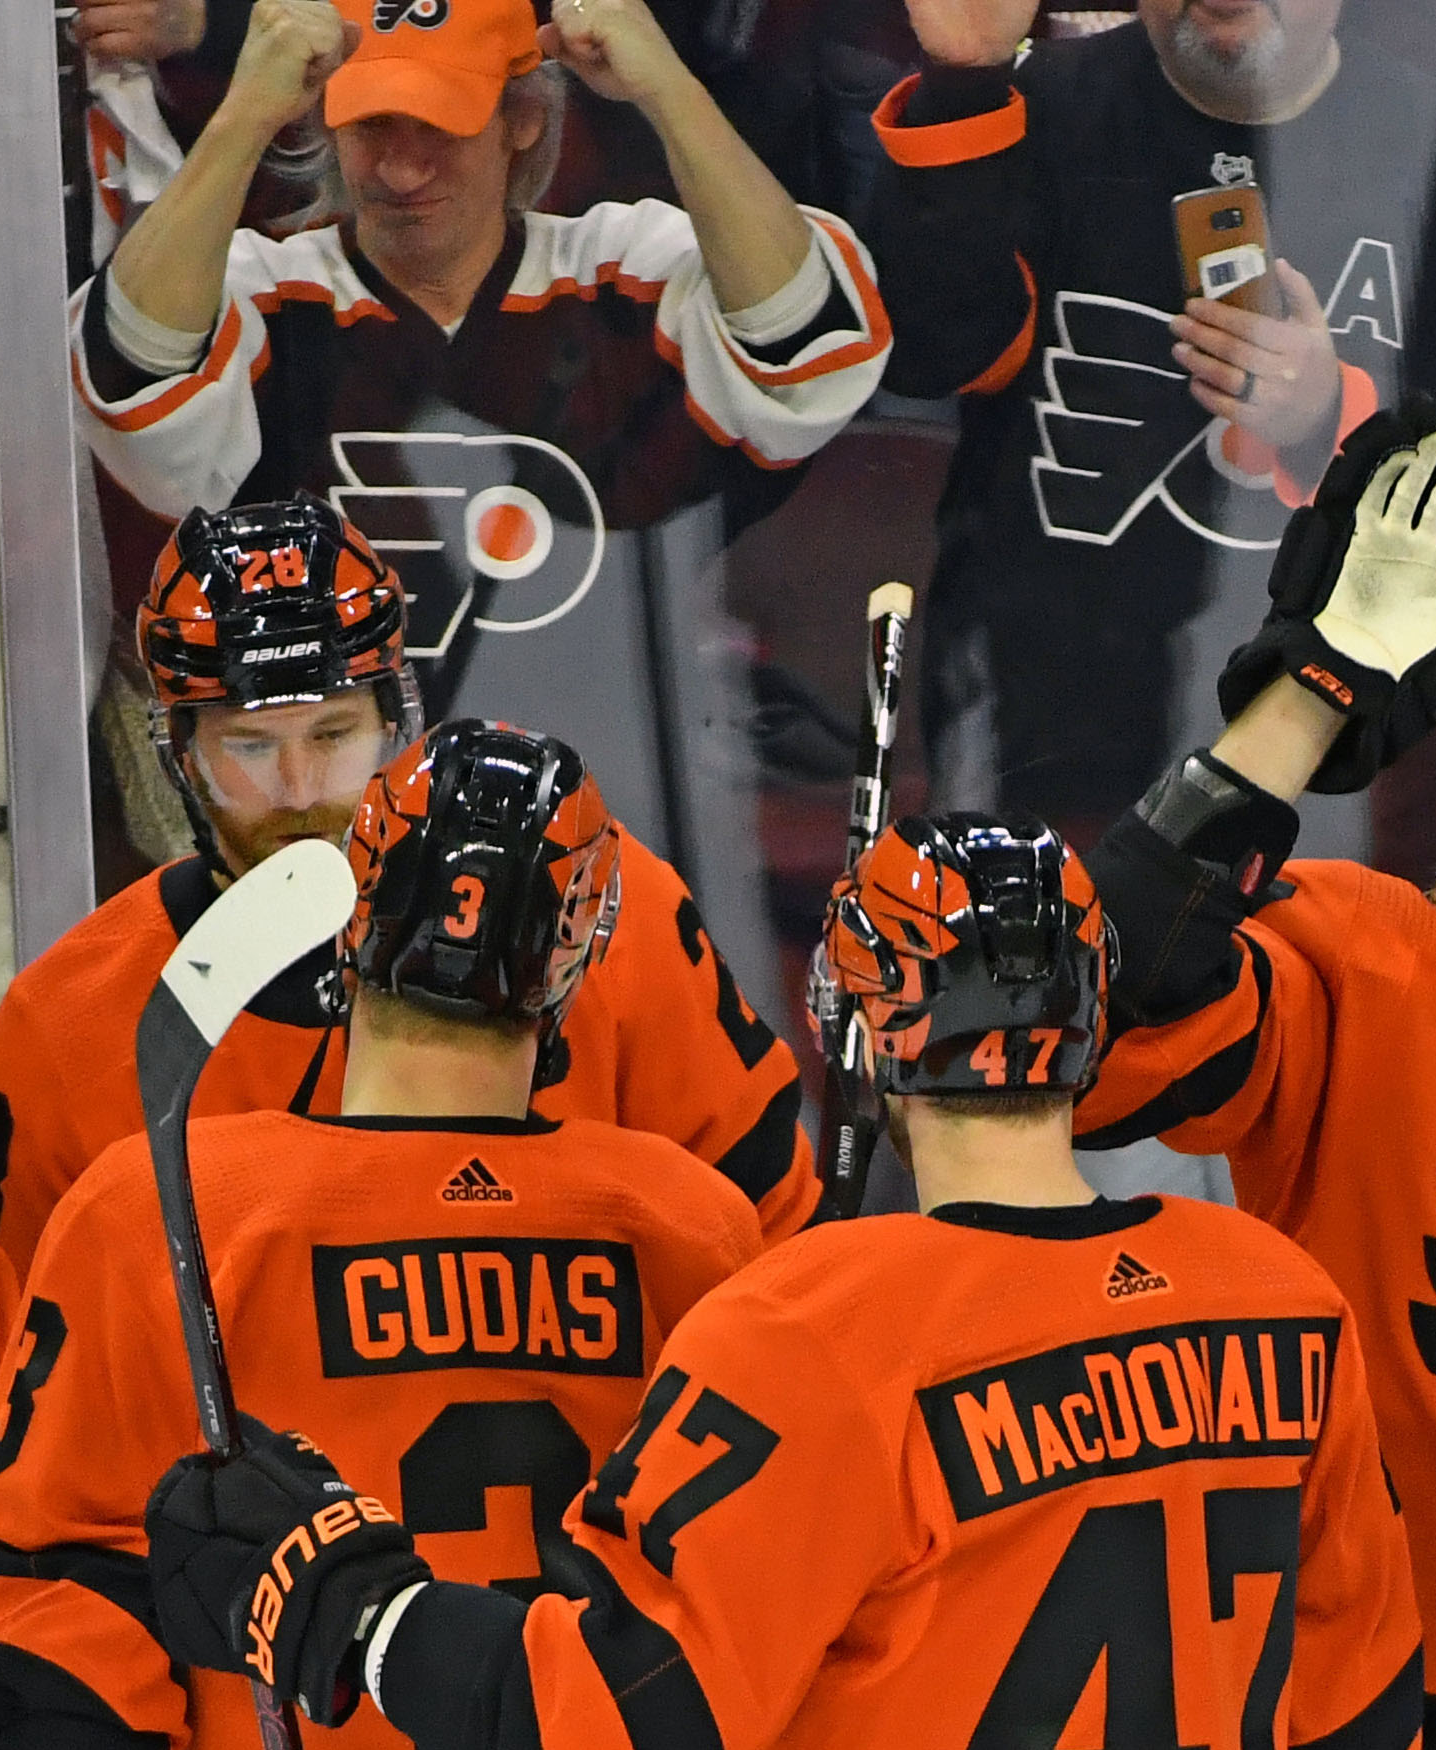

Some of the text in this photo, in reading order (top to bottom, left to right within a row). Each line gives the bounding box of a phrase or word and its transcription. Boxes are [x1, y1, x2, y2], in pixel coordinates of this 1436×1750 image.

[1326, 239, 1403, 349] A
[241, 546, 309, 594] 28
[242, 641, 322, 664] BAUER
[442, 874, 486, 939] 3
[969, 1028, 1063, 1086] 47
[837, 1125, 853, 1178] GIROUX
[441, 1183, 513, 1201] adidas
[343, 1254, 619, 1361] GUDAS
[1106, 1274, 1168, 1298] adidas
[581, 1366, 781, 1580] 47
